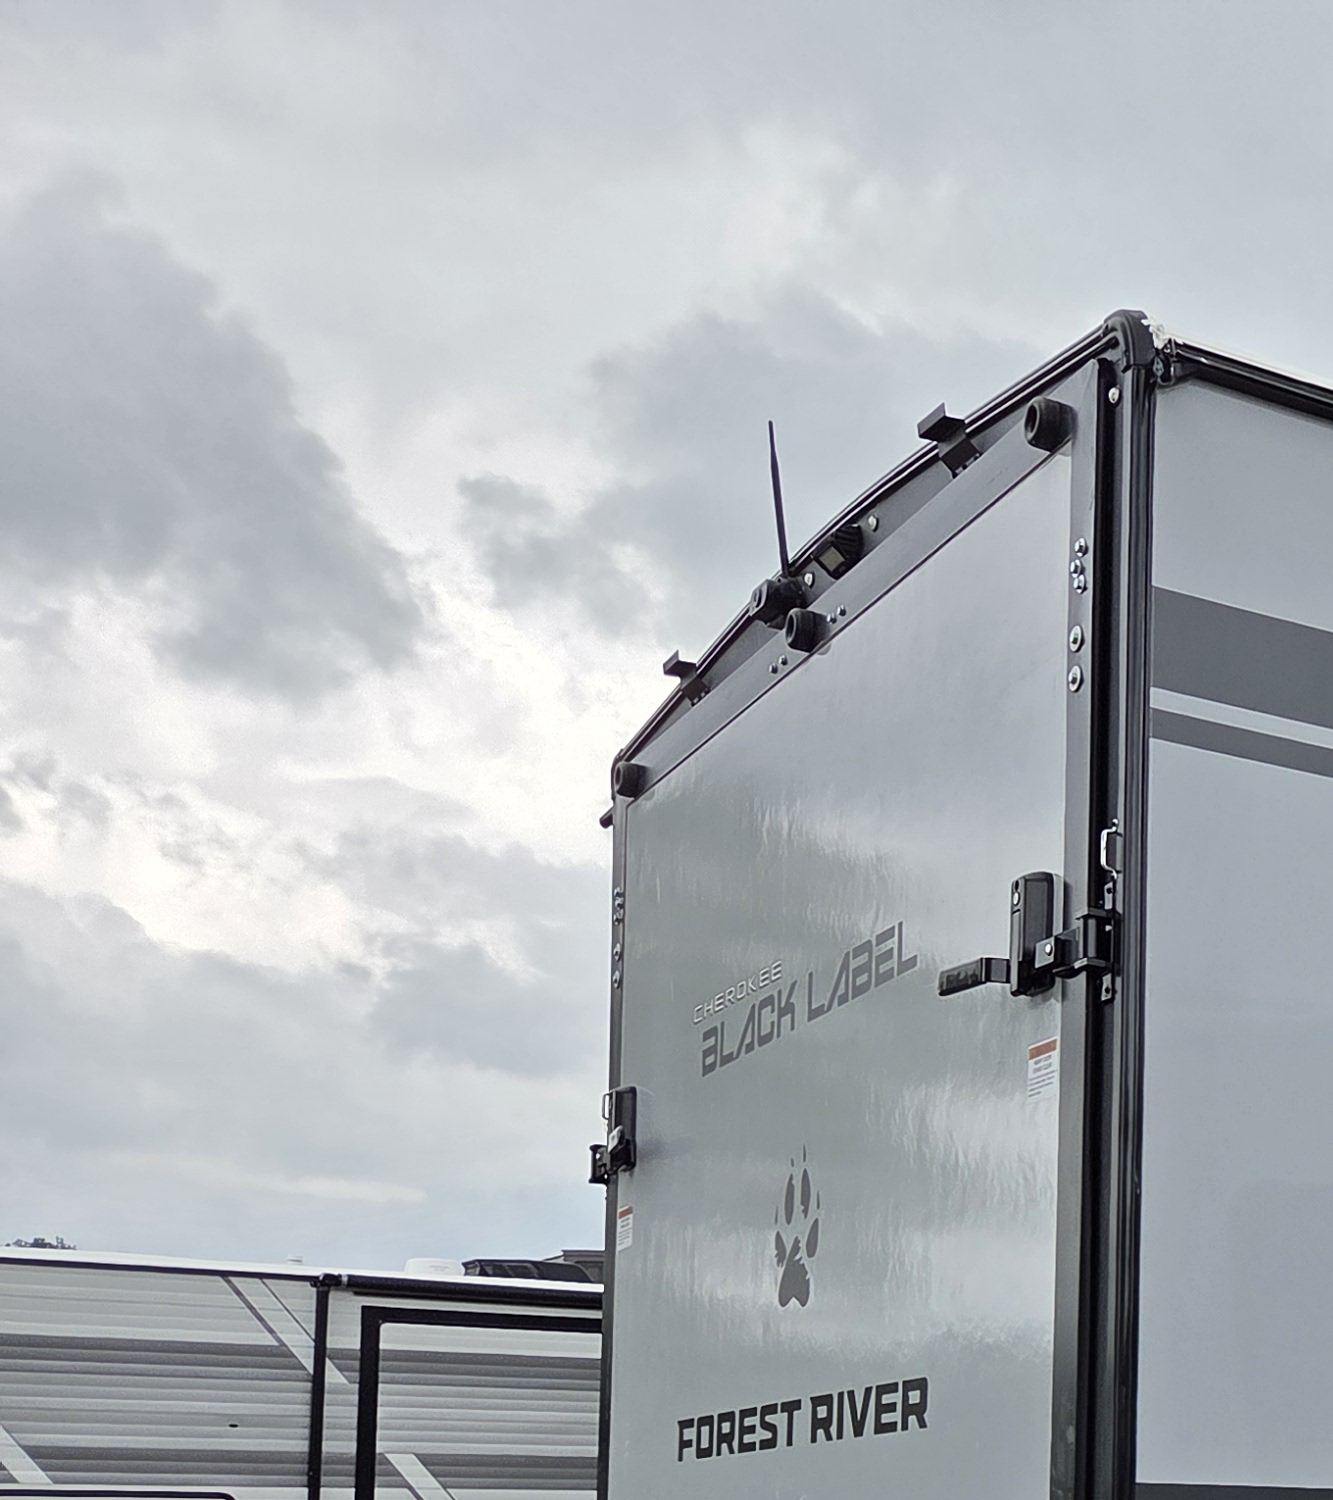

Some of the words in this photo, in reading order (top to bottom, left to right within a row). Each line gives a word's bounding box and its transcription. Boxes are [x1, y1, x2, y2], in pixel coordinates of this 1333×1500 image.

[692, 960, 783, 1026] CHEROKEE
[701, 979, 798, 1078] BLACK
[806, 920, 919, 1023] LABEL
[677, 1398, 803, 1462] FOREST
[809, 1376, 928, 1444] RIVER
